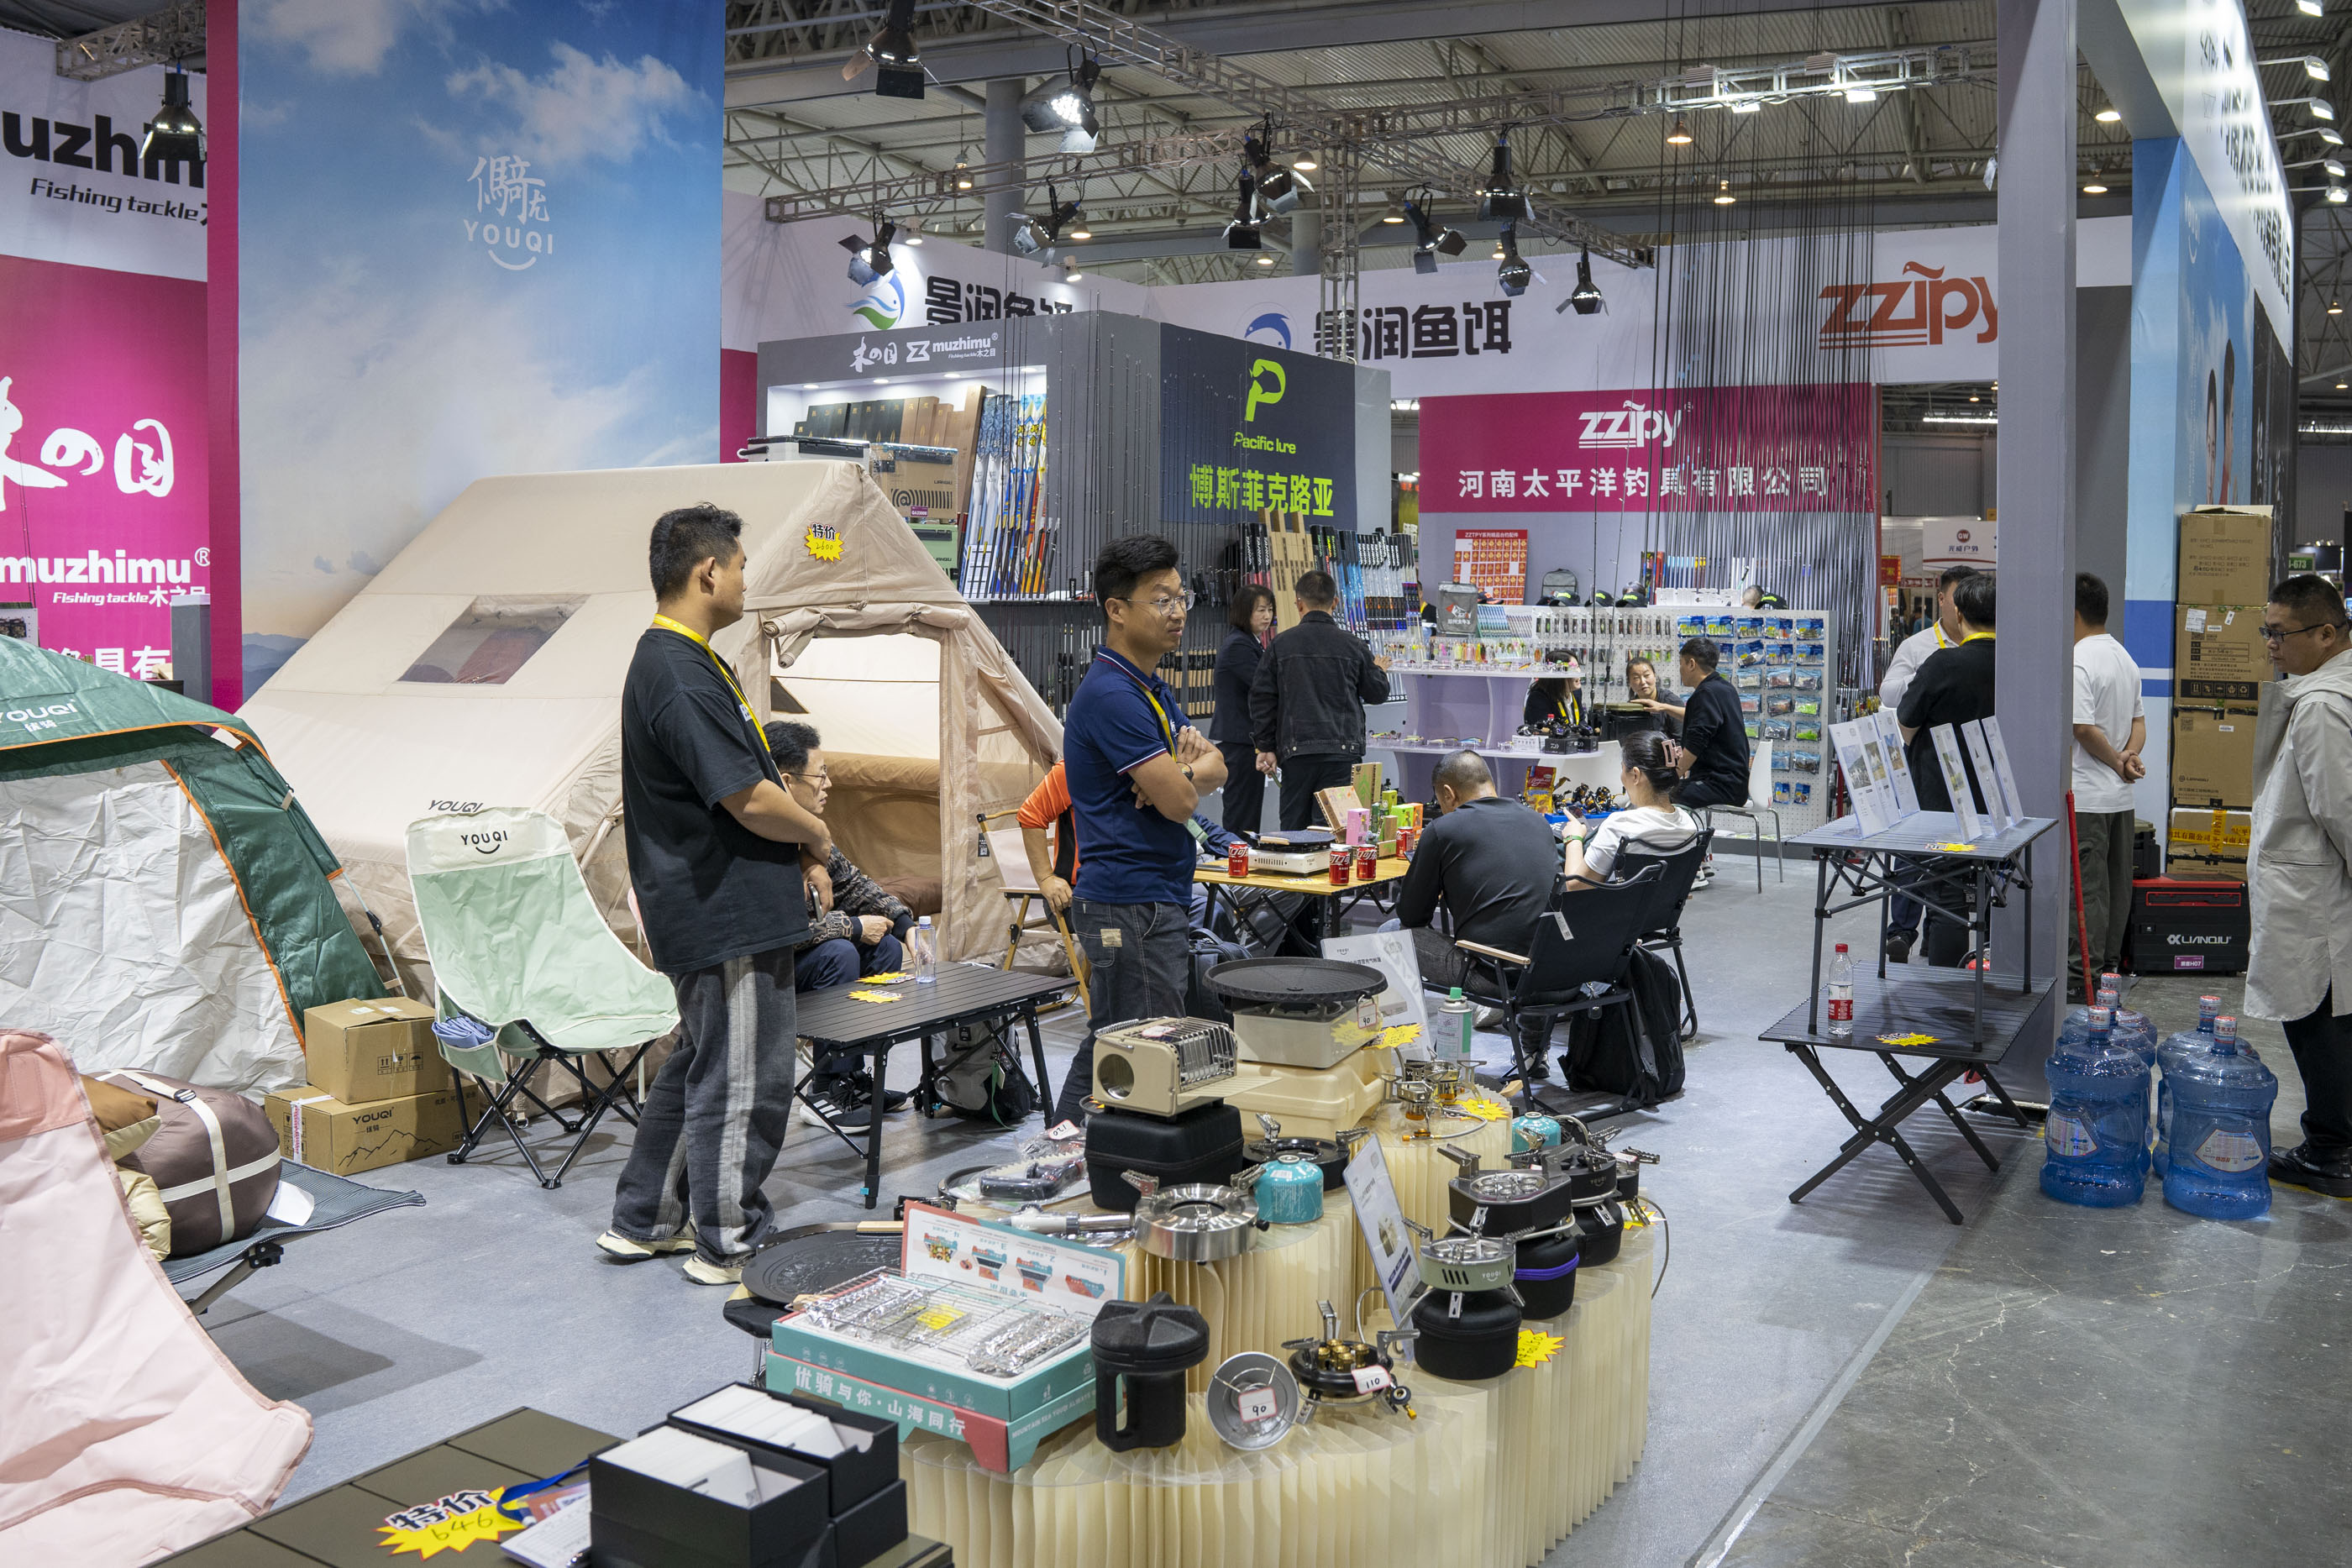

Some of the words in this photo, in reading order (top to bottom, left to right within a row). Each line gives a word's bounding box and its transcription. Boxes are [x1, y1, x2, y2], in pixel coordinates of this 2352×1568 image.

[30, 177, 123, 213] Fishing
[463, 218, 554, 254] YOUQI
[932, 337, 991, 353] muzhimu
[1233, 432, 1273, 452] Pacific
[1276, 438, 1296, 454] lure
[1189, 463, 1334, 517] 博斯菲克路亚
[1458, 466, 1829, 499] 河南太平洋钓具有限公司
[812, 523, 836, 540] 特价
[816, 541, 833, 550] 2600
[0, 549, 191, 584] muzhimu
[53, 591, 105, 606] Fishing
[107, 592, 149, 603] tackle
[0, 702, 77, 724] OUQI
[24, 720, 57, 732] 优骑
[428, 800, 484, 813] YOUQI
[460, 830, 508, 847] YOUQI
[2181, 936, 2229, 944] LIANQIU
[1362, 1016, 1371, 1025] 90
[352, 1109, 393, 1125] YOUQI
[1482, 1270, 1501, 1278] YOUQI
[1366, 1377, 1380, 1388] 110
[1252, 1404, 1267, 1416] 90
[390, 1492, 492, 1529] 特价
[431, 1513, 493, 1541] 646
